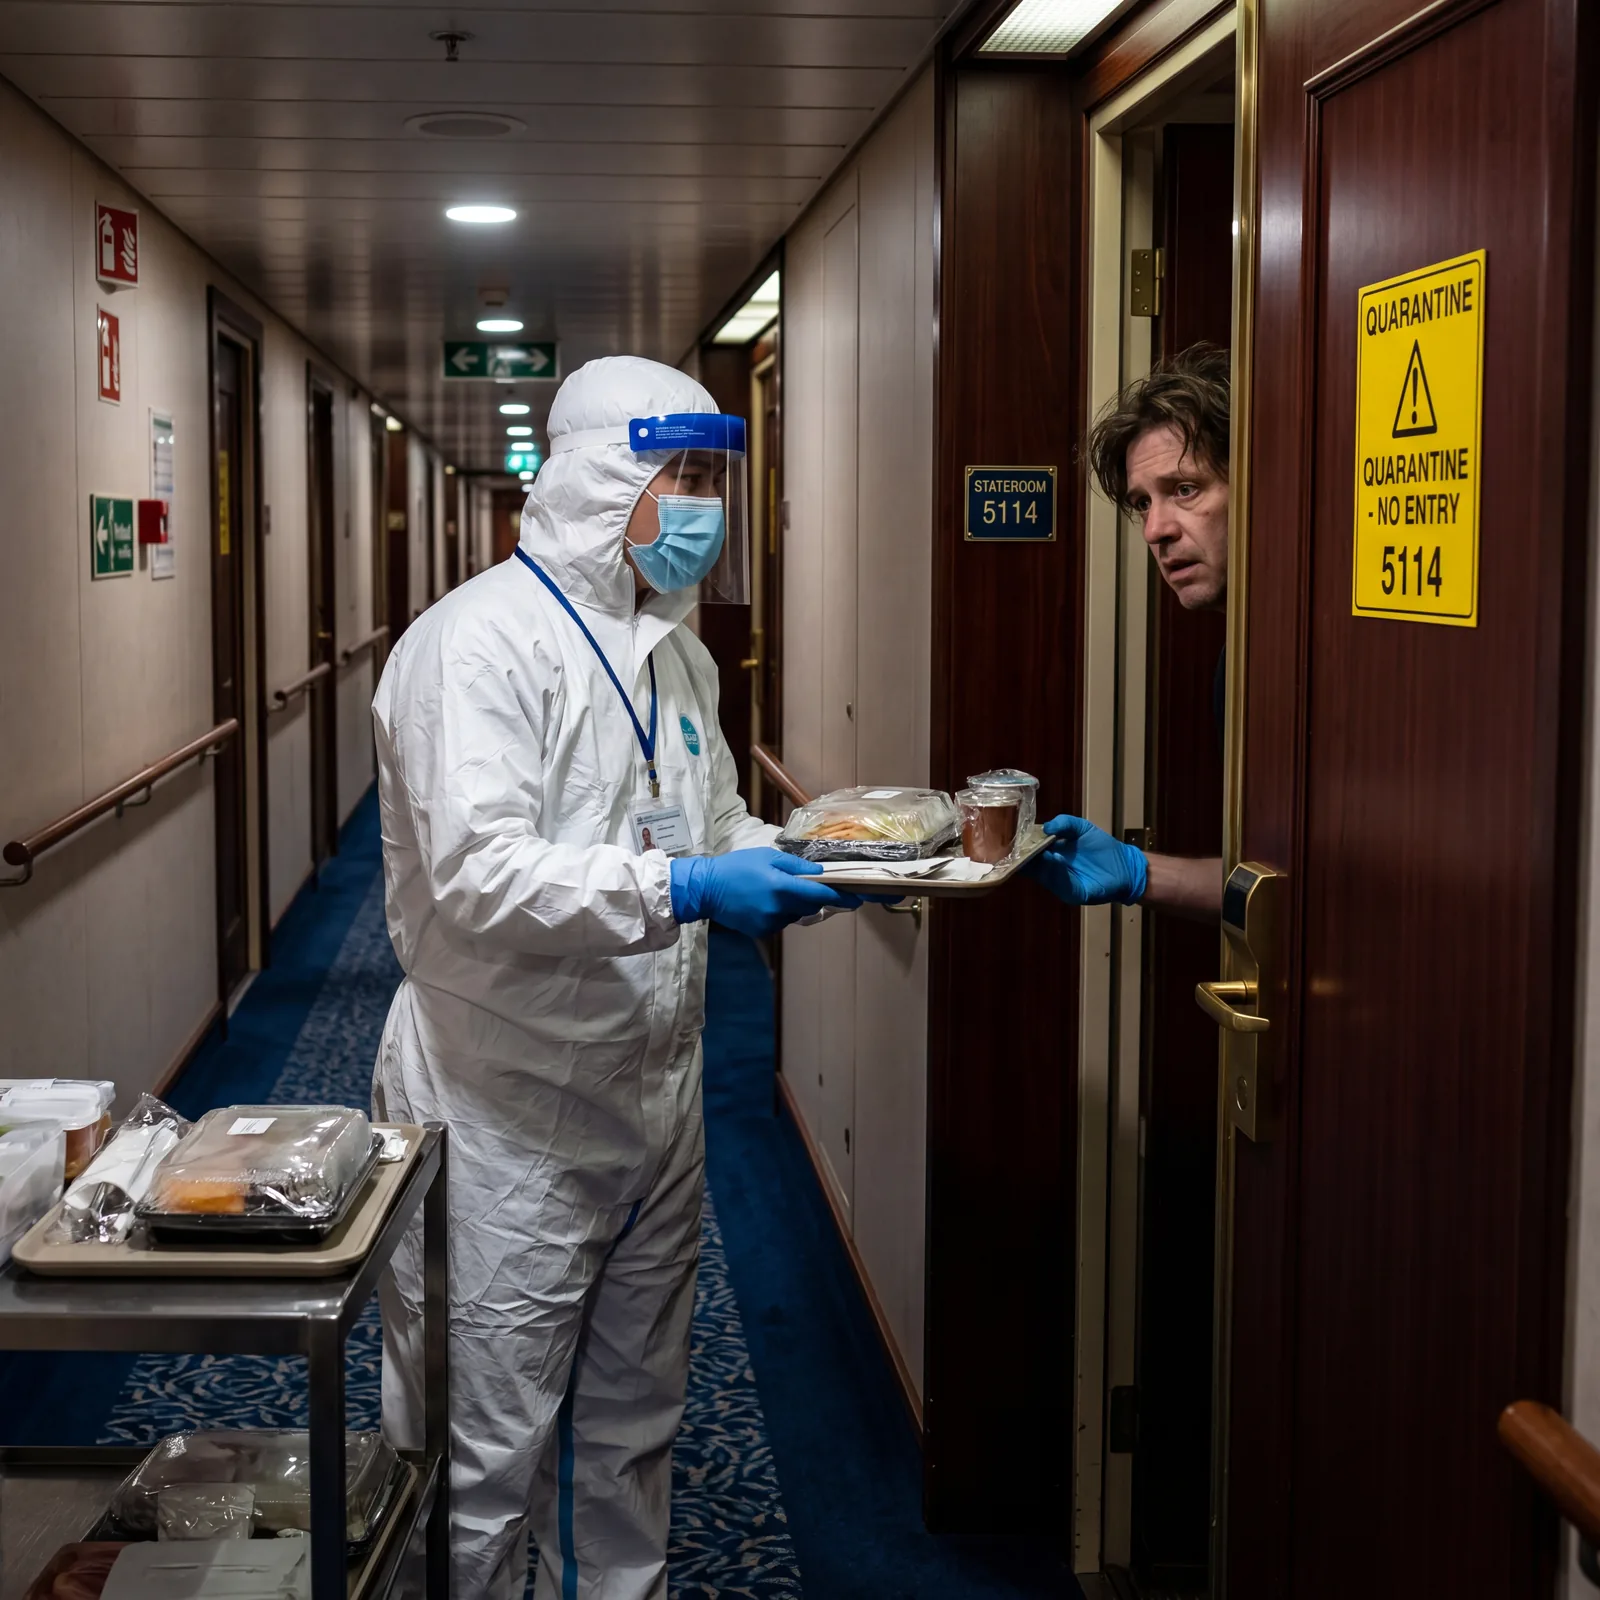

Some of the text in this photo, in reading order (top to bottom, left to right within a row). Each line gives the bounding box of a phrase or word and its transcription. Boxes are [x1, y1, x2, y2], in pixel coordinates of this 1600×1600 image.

[1366, 279, 1473, 336] QUARANTINE
[1364, 448, 1469, 486] QUARANTINE
[975, 480, 1046, 493] STATEROOM
[983, 500, 1038, 525] 5114
[1377, 496, 1400, 526] NO
[1405, 493, 1460, 525] ENTRY
[1381, 545, 1443, 597] 5114
